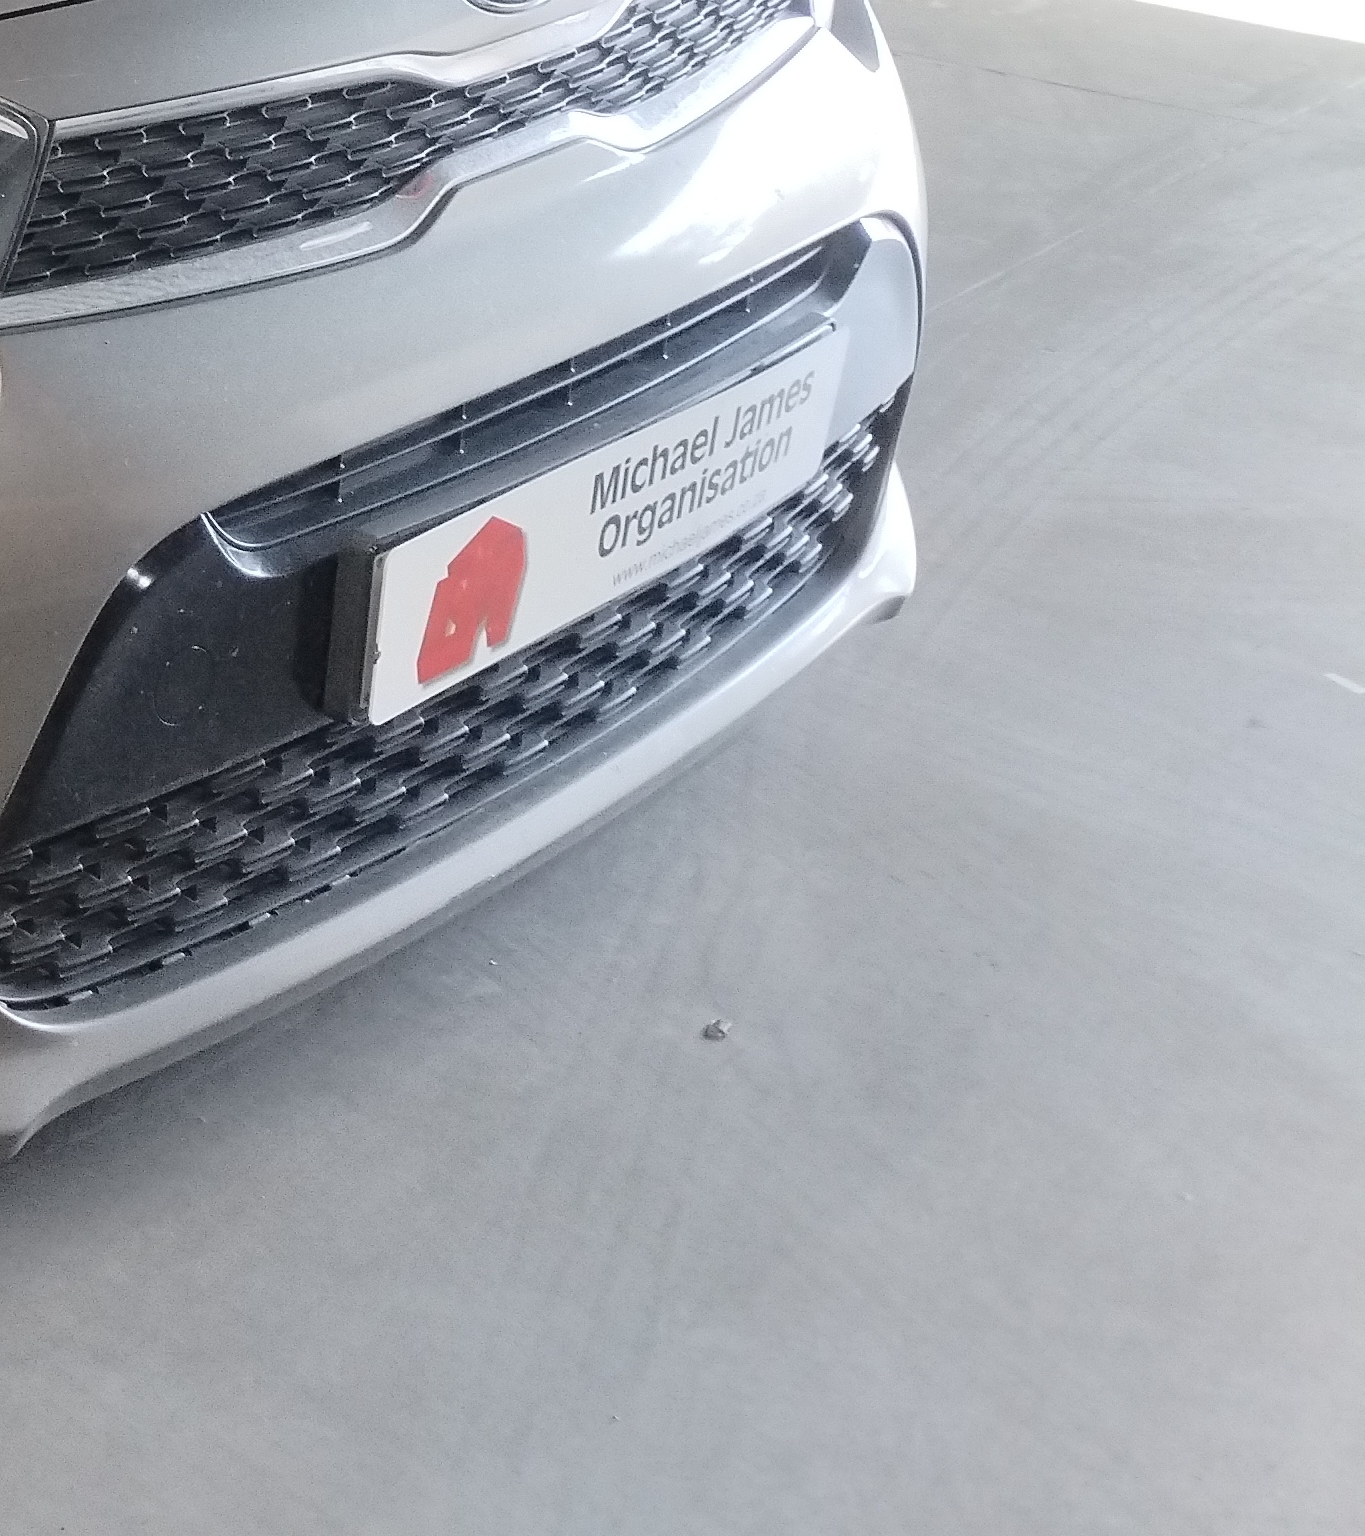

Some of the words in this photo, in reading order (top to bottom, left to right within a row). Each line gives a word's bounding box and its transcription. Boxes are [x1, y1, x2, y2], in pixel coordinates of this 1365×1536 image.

[589, 415, 721, 516] Michael
[724, 370, 815, 448] James
[597, 425, 794, 559] Organisation
